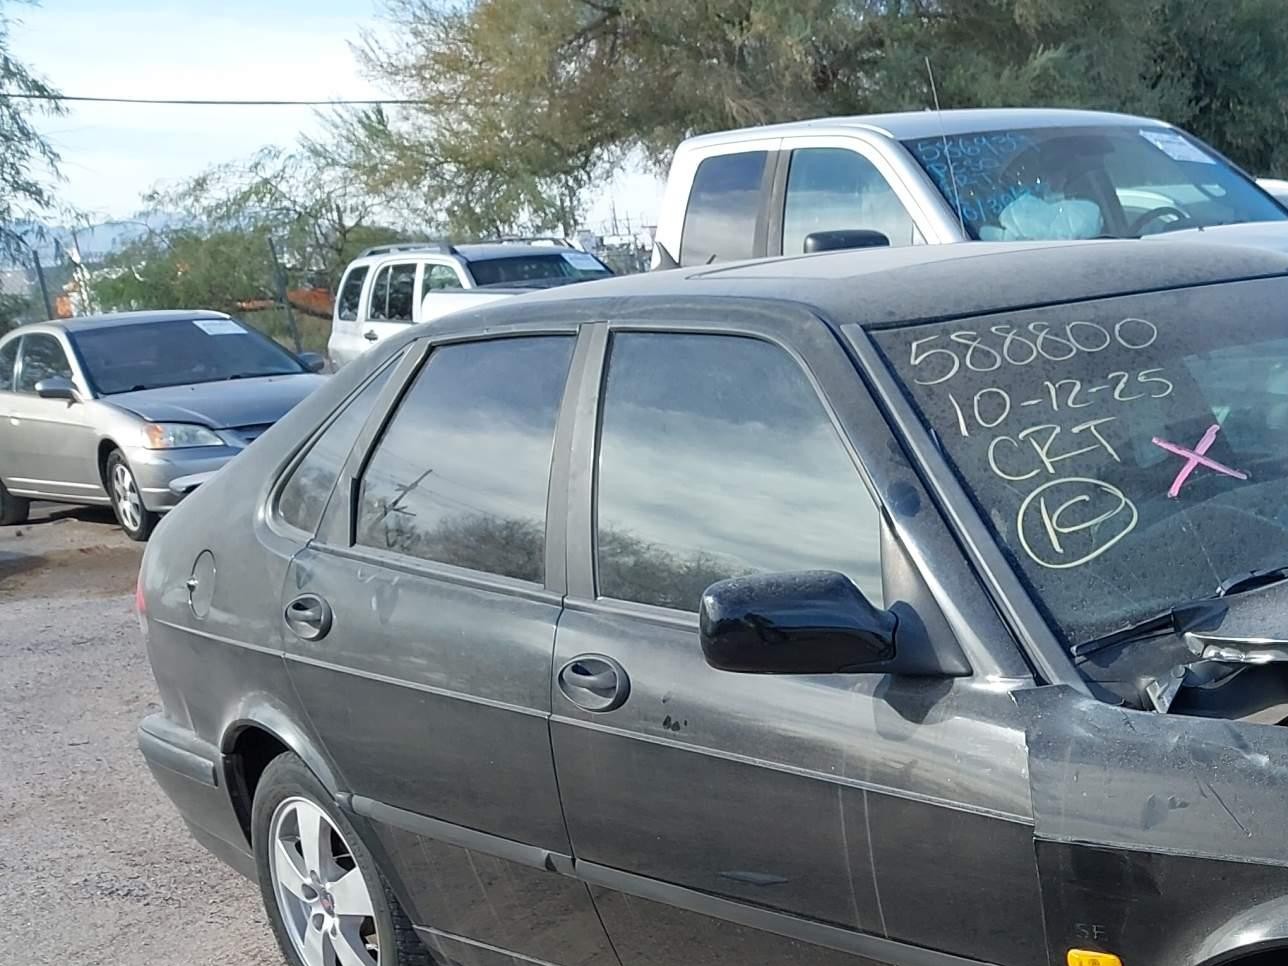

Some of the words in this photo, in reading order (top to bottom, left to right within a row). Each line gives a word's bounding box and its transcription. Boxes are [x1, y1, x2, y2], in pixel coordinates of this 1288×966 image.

[910, 317, 1158, 385] 588800
[948, 367, 1174, 437] 10-12-25
[987, 416, 1121, 481] CRT
